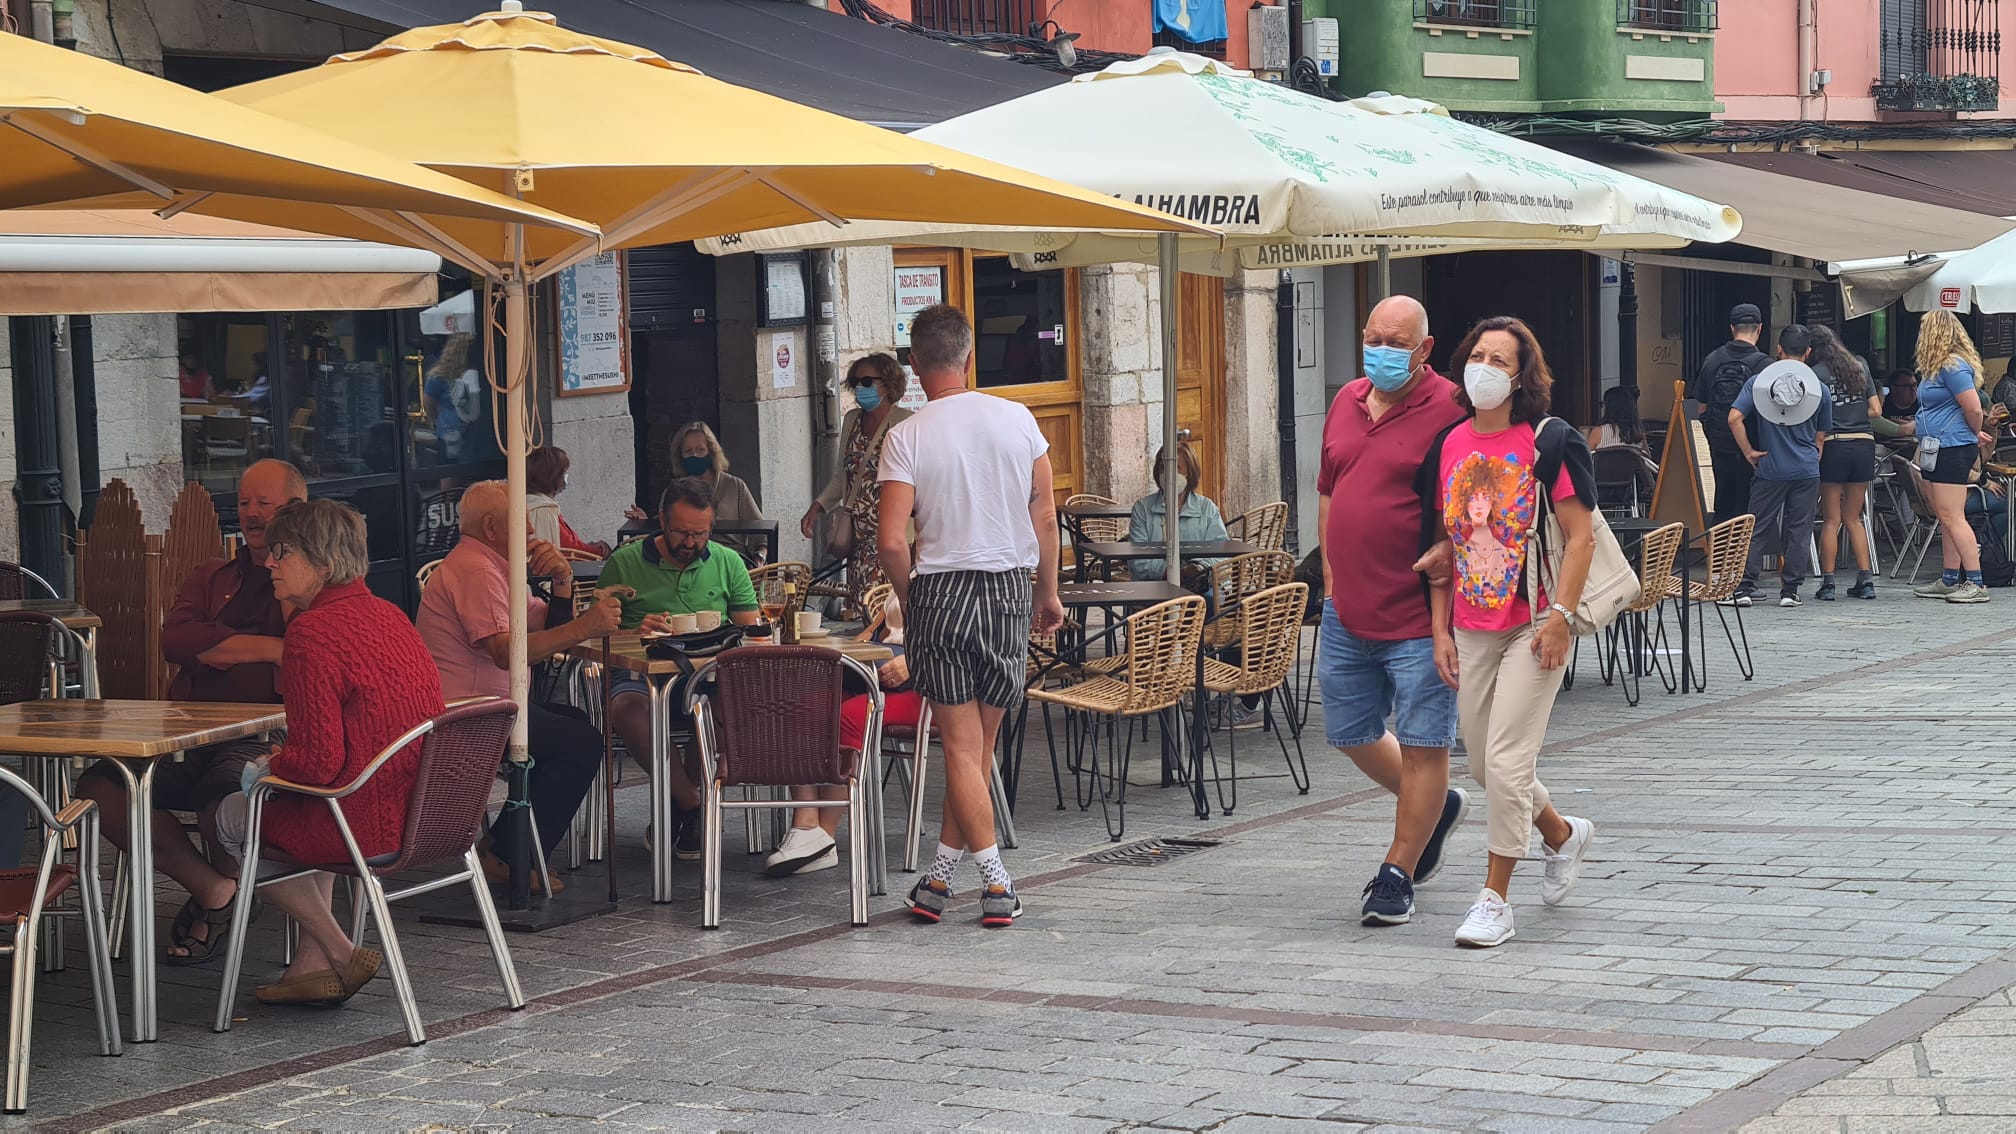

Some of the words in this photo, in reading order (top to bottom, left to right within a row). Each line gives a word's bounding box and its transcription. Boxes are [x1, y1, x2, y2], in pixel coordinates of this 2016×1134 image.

[1381, 194, 1396, 210] Este
[1397, 188, 1428, 213] parasol
[1428, 185, 1466, 210] contribuye
[1473, 190, 1491, 207] que
[1519, 194, 1536, 207] aire
[898, 274, 912, 288] TASCA
[913, 274, 919, 288] DE
[593, 332, 604, 342] 352
[604, 331, 617, 341] 096
[428, 502, 461, 529] SU
